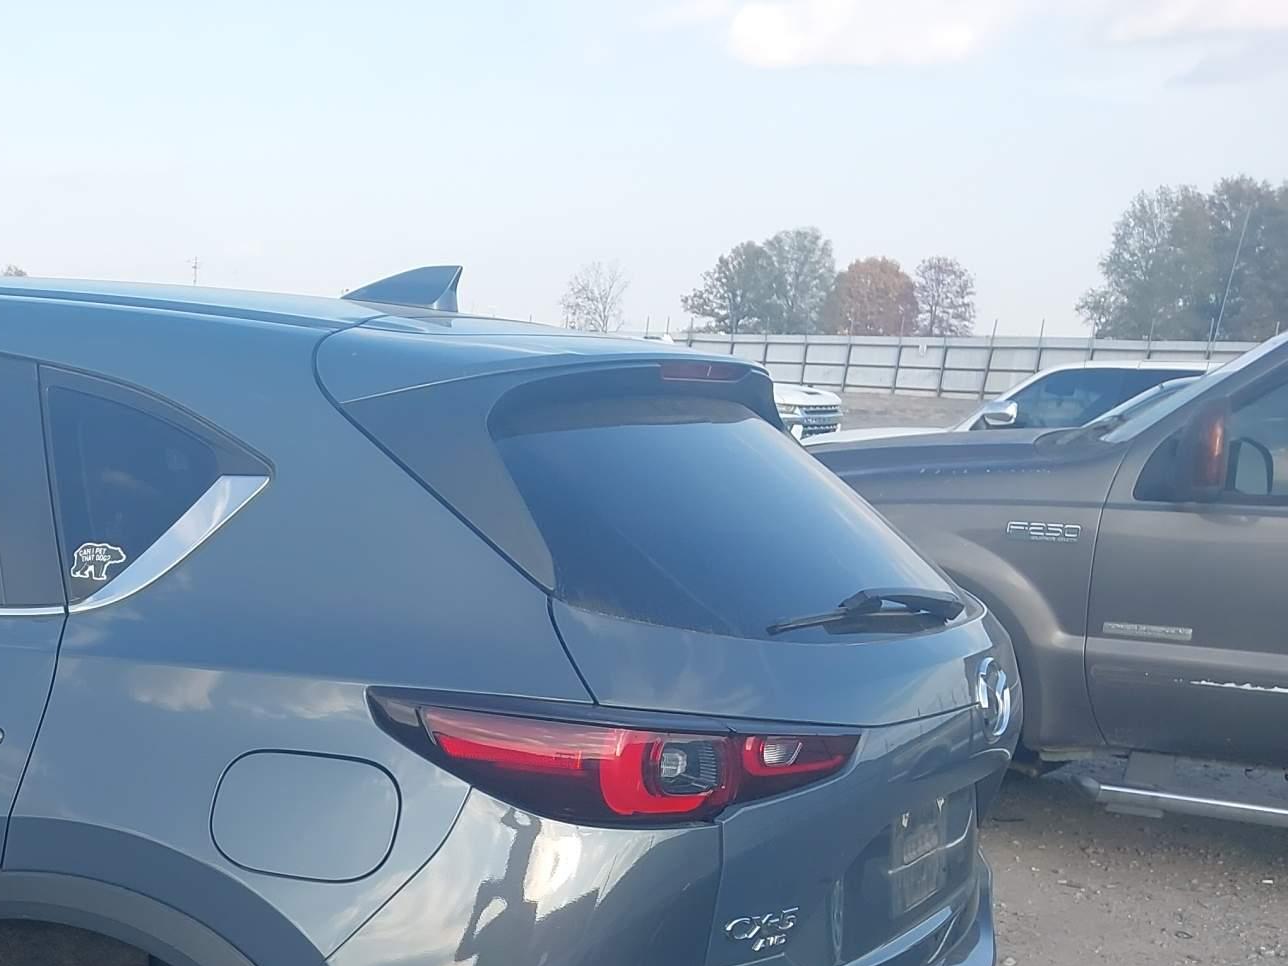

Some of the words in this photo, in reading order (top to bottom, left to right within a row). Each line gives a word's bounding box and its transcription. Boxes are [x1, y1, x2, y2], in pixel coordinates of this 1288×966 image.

[1006, 521, 1081, 538] F-250
[79, 548, 91, 556] CAN
[725, 907, 799, 940] CX-5
